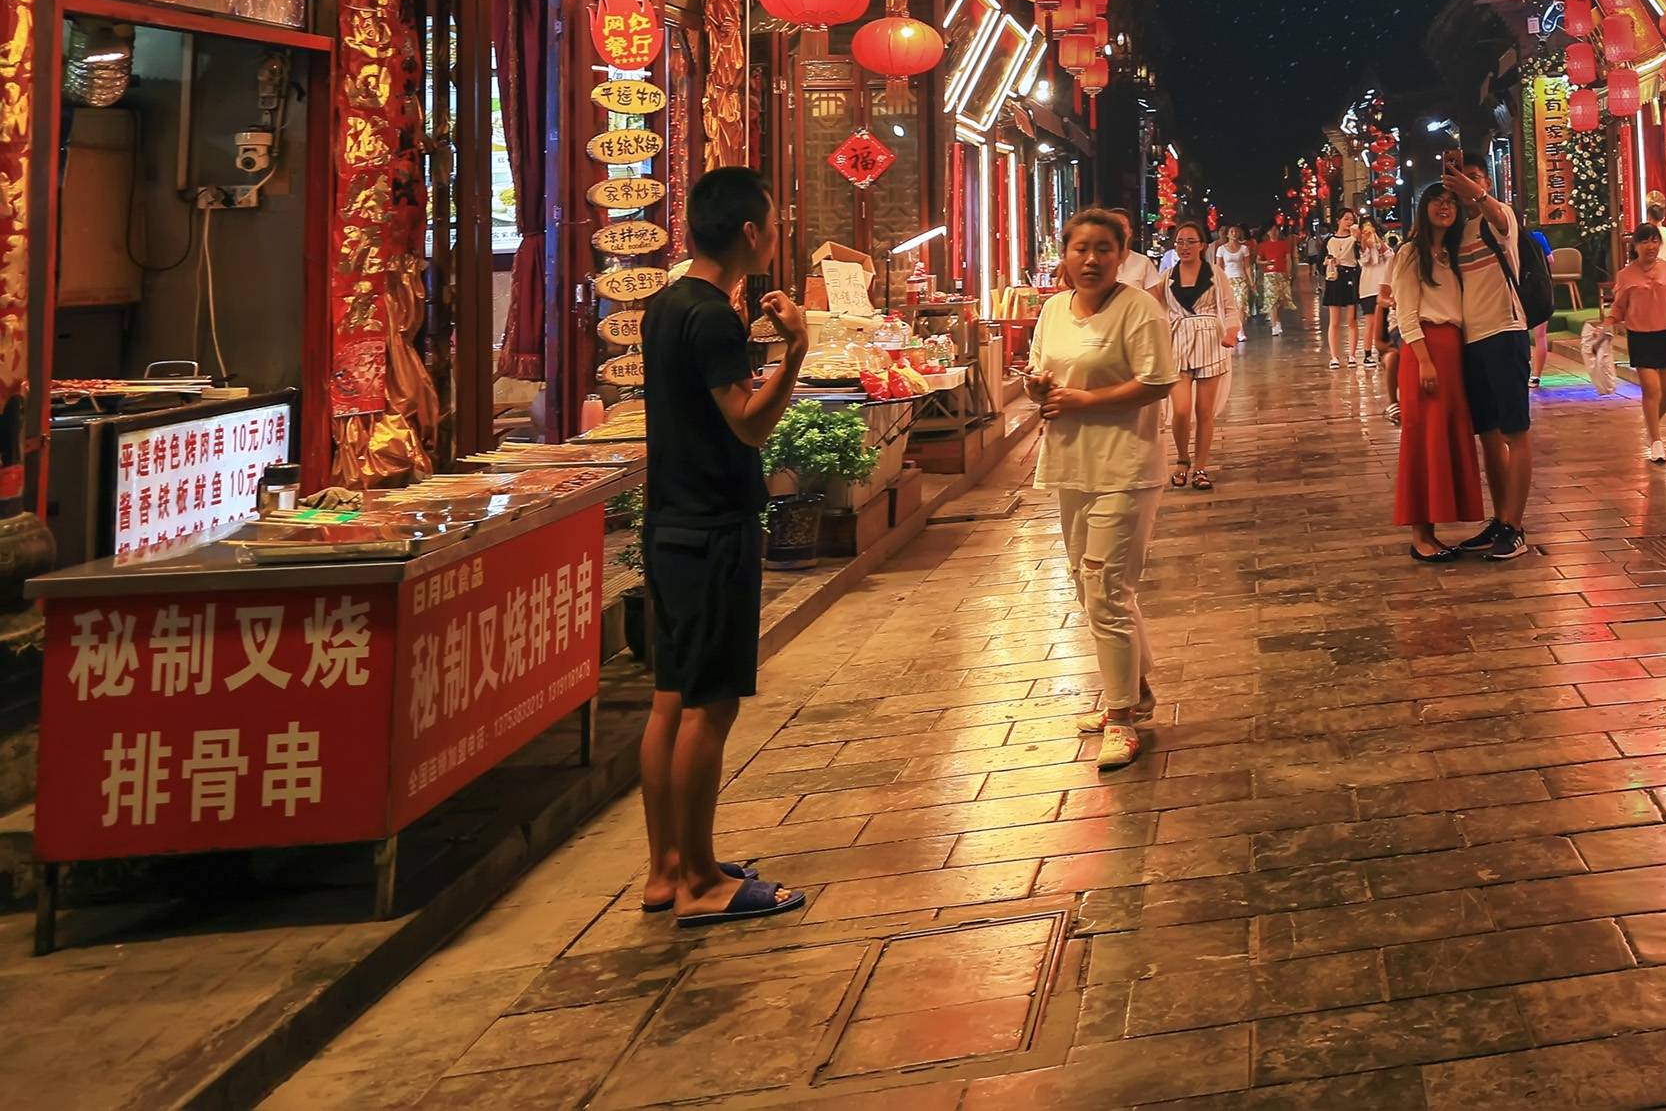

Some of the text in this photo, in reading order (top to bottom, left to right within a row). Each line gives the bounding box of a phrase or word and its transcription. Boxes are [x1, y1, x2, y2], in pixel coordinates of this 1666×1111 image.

[602, 12, 652, 37] 网红
[604, 34, 654, 57] 餐厅
[600, 86, 662, 107] 平遥牛肉
[600, 131, 660, 157] 传统火锅
[849, 146, 876, 173] 福
[603, 183, 661, 203] 家常炒菜
[606, 272, 665, 293] 农家野菜
[119, 412, 286, 482] 平遥特色烤肉串 10元/3串
[118, 471, 223, 533] 酱香铁板鱿鱼
[68, 597, 372, 702] 秘制叉烧
[409, 552, 593, 740] 秘制叉烧排骨串
[102, 721, 325, 827] 排骨串
